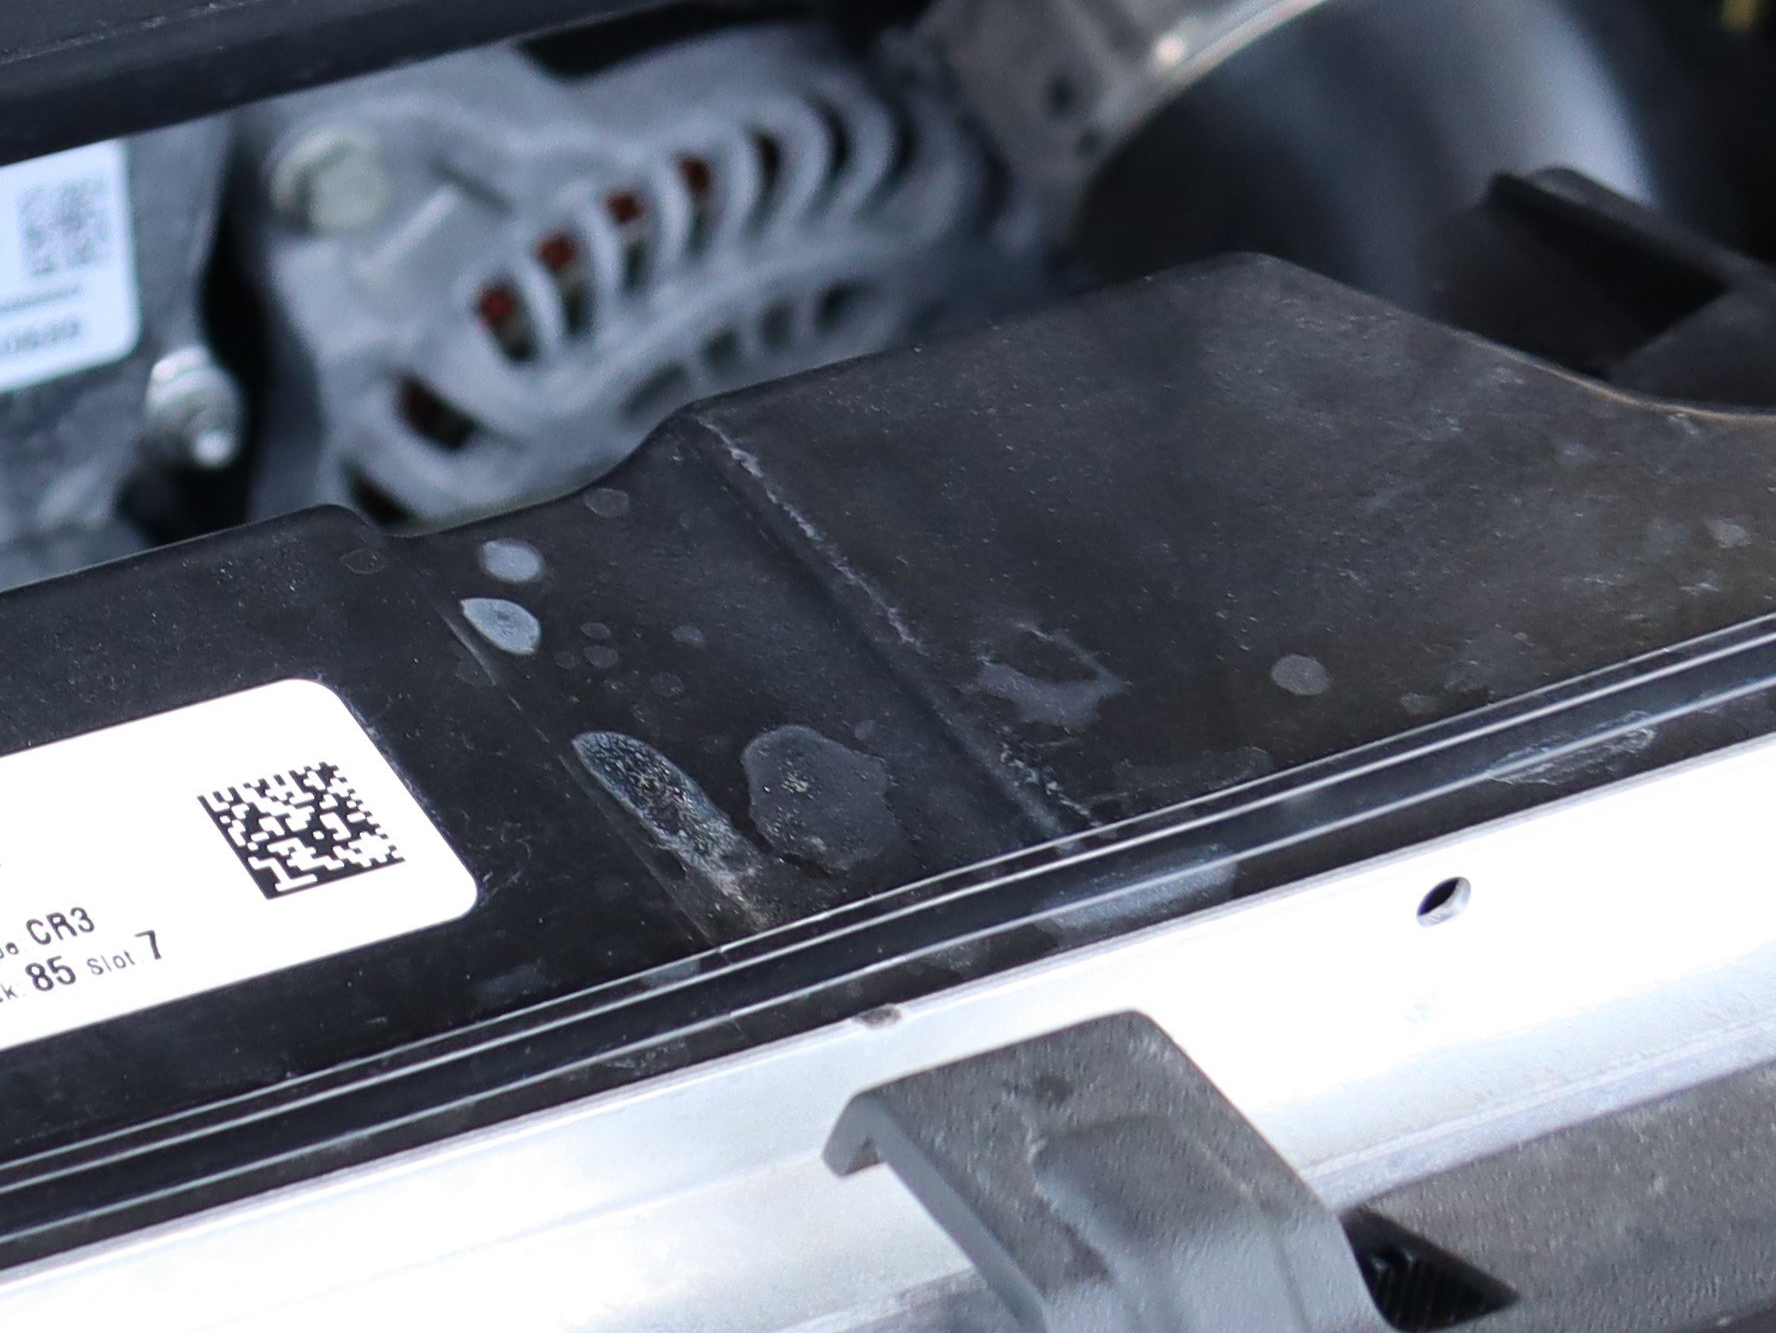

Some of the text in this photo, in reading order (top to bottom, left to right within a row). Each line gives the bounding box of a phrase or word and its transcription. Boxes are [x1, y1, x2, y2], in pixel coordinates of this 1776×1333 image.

[25, 906, 95, 945] CR3
[24, 955, 77, 992] 85
[133, 929, 162, 960] 7
